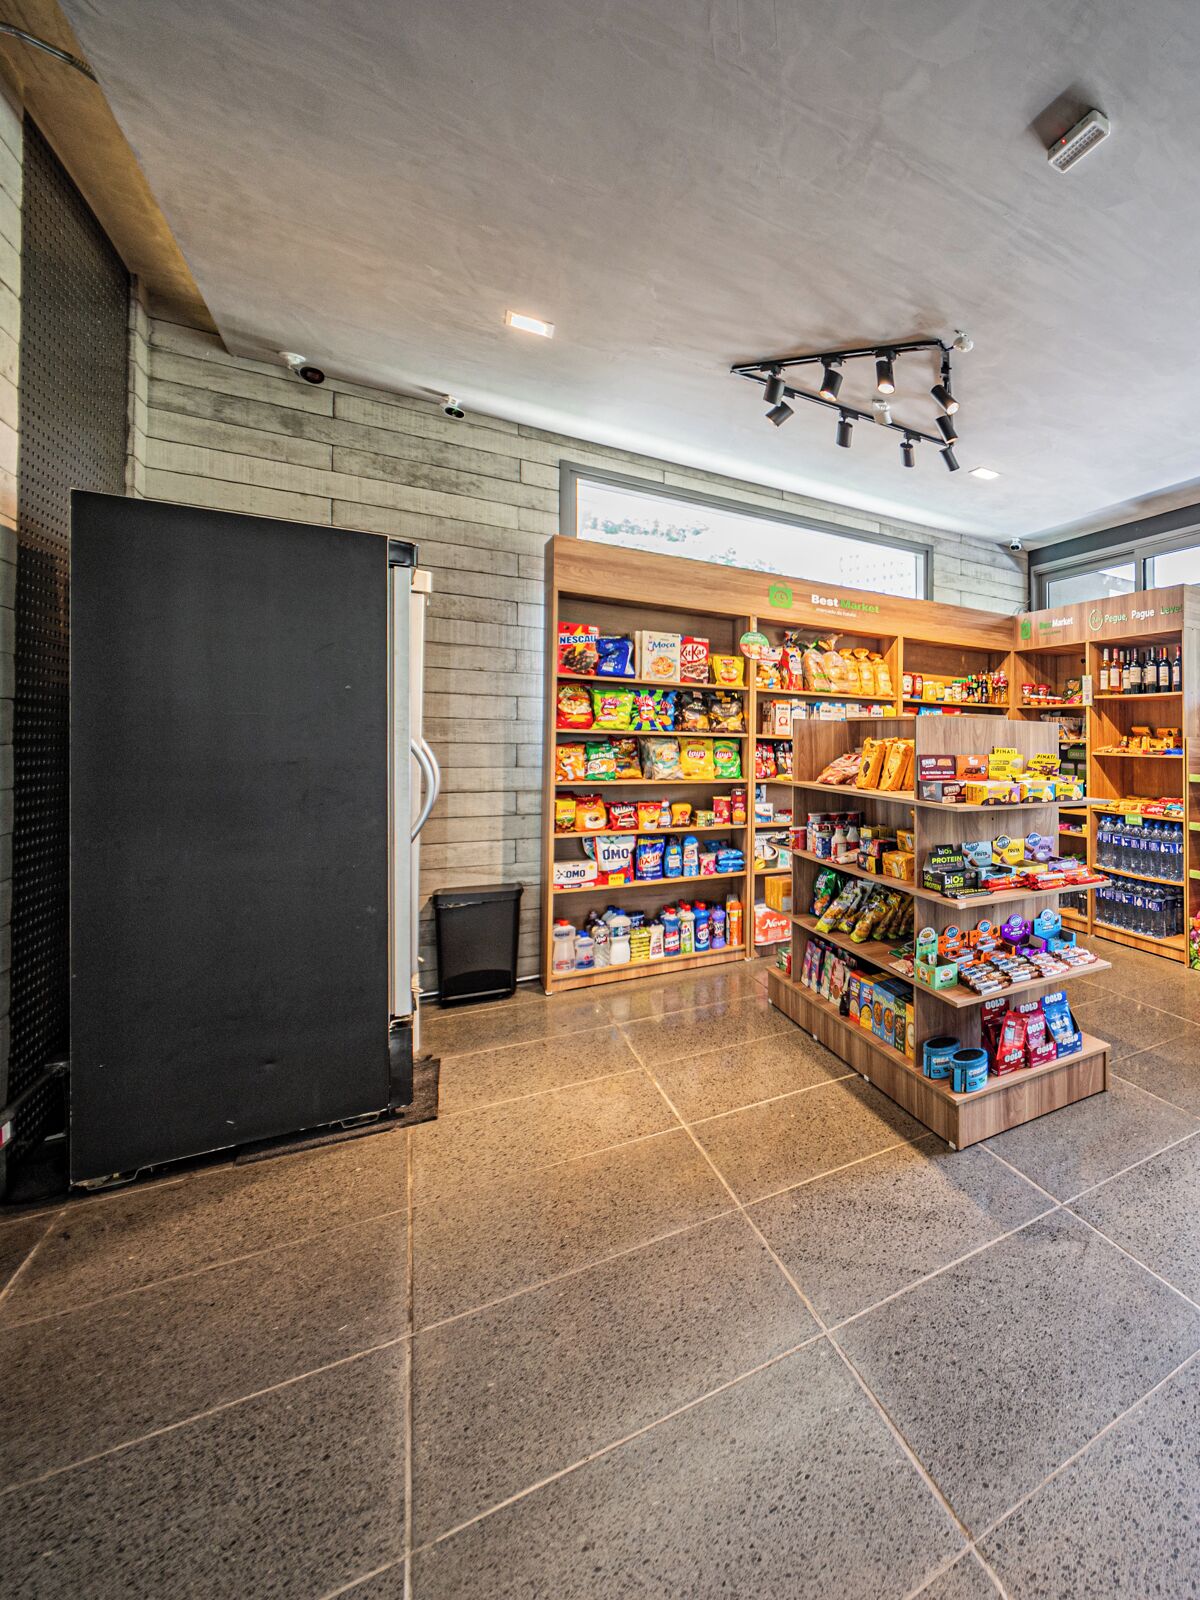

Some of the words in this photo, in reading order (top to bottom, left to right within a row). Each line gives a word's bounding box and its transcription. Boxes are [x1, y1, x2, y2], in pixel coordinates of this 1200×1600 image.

[811, 594, 839, 608] Best
[840, 598, 880, 614] Market
[1131, 609, 1155, 620] Pague
[1052, 616, 1073, 628] Market
[559, 634, 597, 645] NESCAU
[652, 641, 676, 649] Moça
[602, 848, 629, 861] OMO
[931, 856, 963, 864] PROTEIN
[566, 869, 586, 878] OMO
[762, 918, 787, 929] Neve
